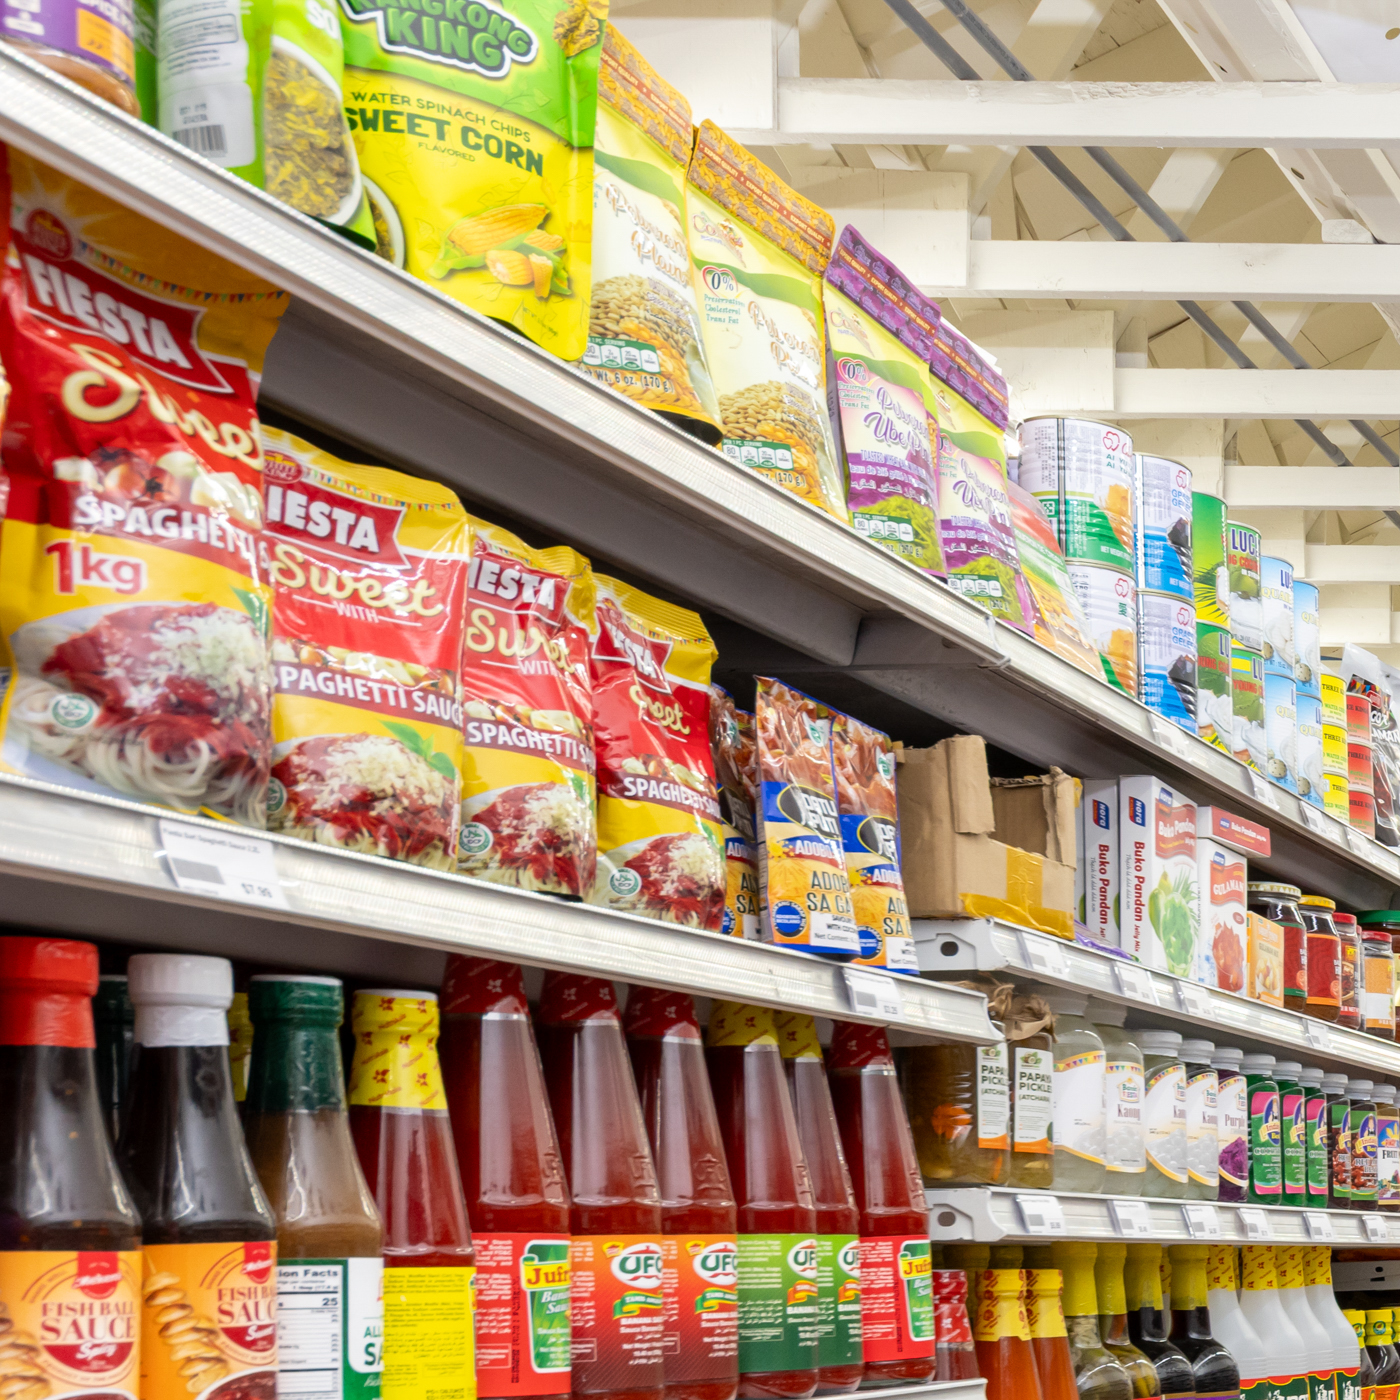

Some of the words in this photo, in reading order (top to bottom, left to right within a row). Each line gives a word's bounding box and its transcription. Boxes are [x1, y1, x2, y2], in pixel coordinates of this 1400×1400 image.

[385, 7, 503, 65] KING
[350, 91, 411, 110] WATER
[414, 95, 488, 130] SPINACH
[491, 119, 531, 143] CHIPS
[347, 107, 451, 139] SWEET
[462, 127, 544, 177] CORN
[418, 141, 476, 163] FLAVORED
[25, 256, 194, 372] FIESTA
[267, 486, 379, 553] IESTA
[46, 541, 144, 595] 1kg
[271, 544, 443, 617] Sweet
[336, 602, 379, 623] WITH
[1134, 841, 1145, 873] Buko
[1134, 875, 1144, 923] Pandan
[1212, 878, 1244, 896] GULAMAN
[526, 1267, 570, 1286] Jufr
[41, 1302, 94, 1316] FISH
[322, 1298, 338, 1307] 25
[41, 1317, 134, 1342] SAUCE
